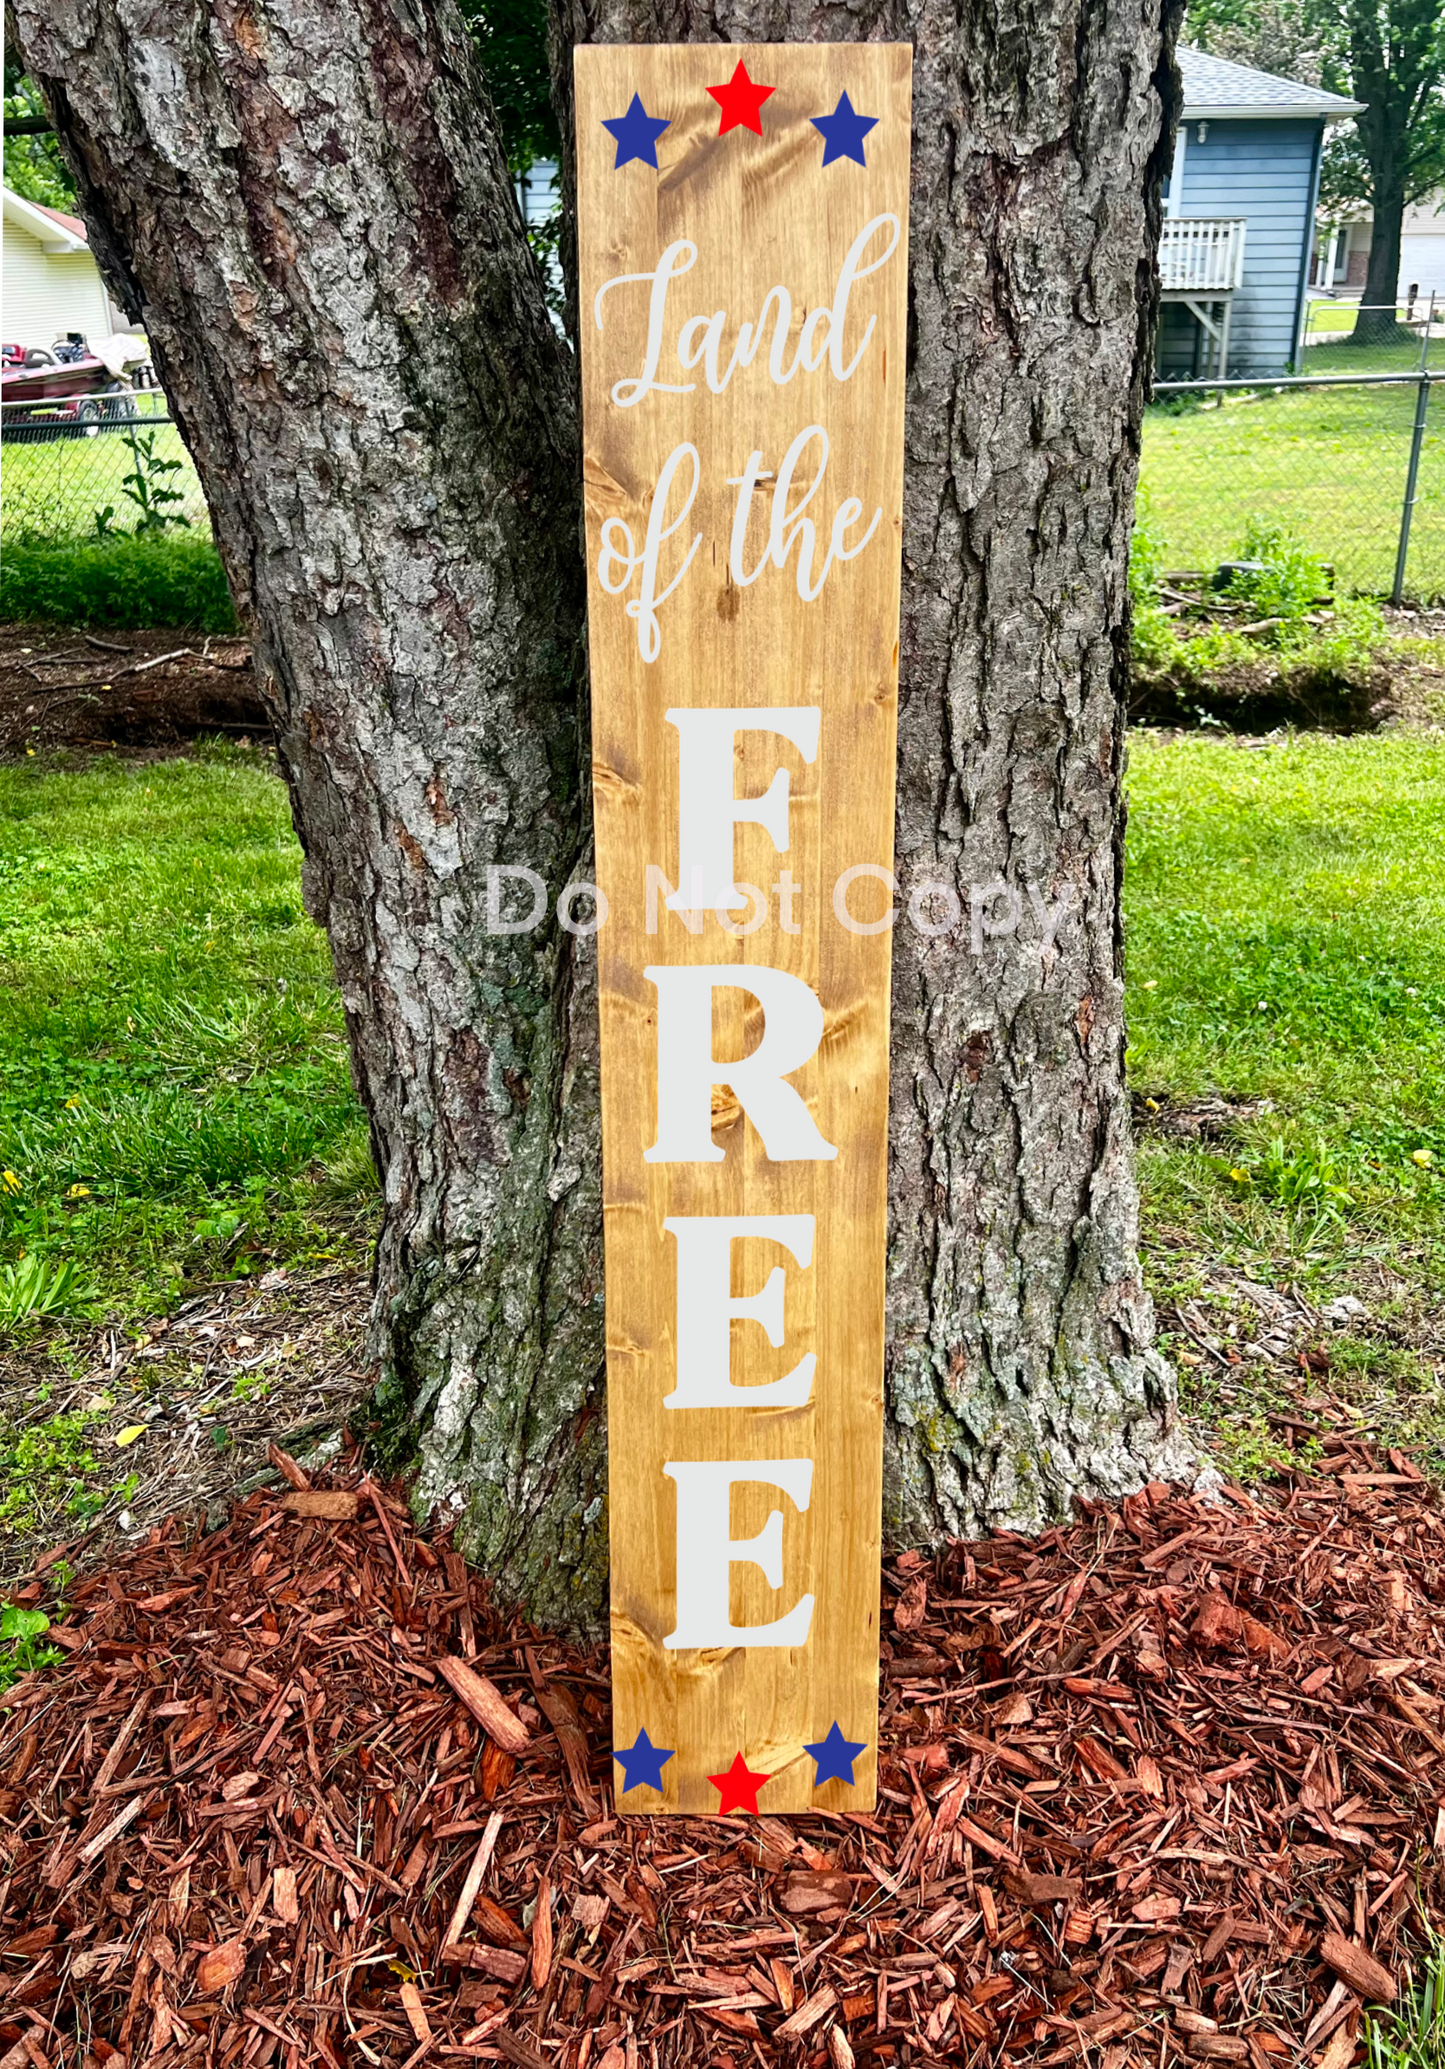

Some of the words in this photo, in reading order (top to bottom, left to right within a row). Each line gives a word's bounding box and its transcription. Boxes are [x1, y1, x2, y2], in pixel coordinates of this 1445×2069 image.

[594, 212, 900, 407] Land
[597, 442, 702, 664] of
[726, 424, 882, 602] the
[642, 706, 839, 1651] FREE
